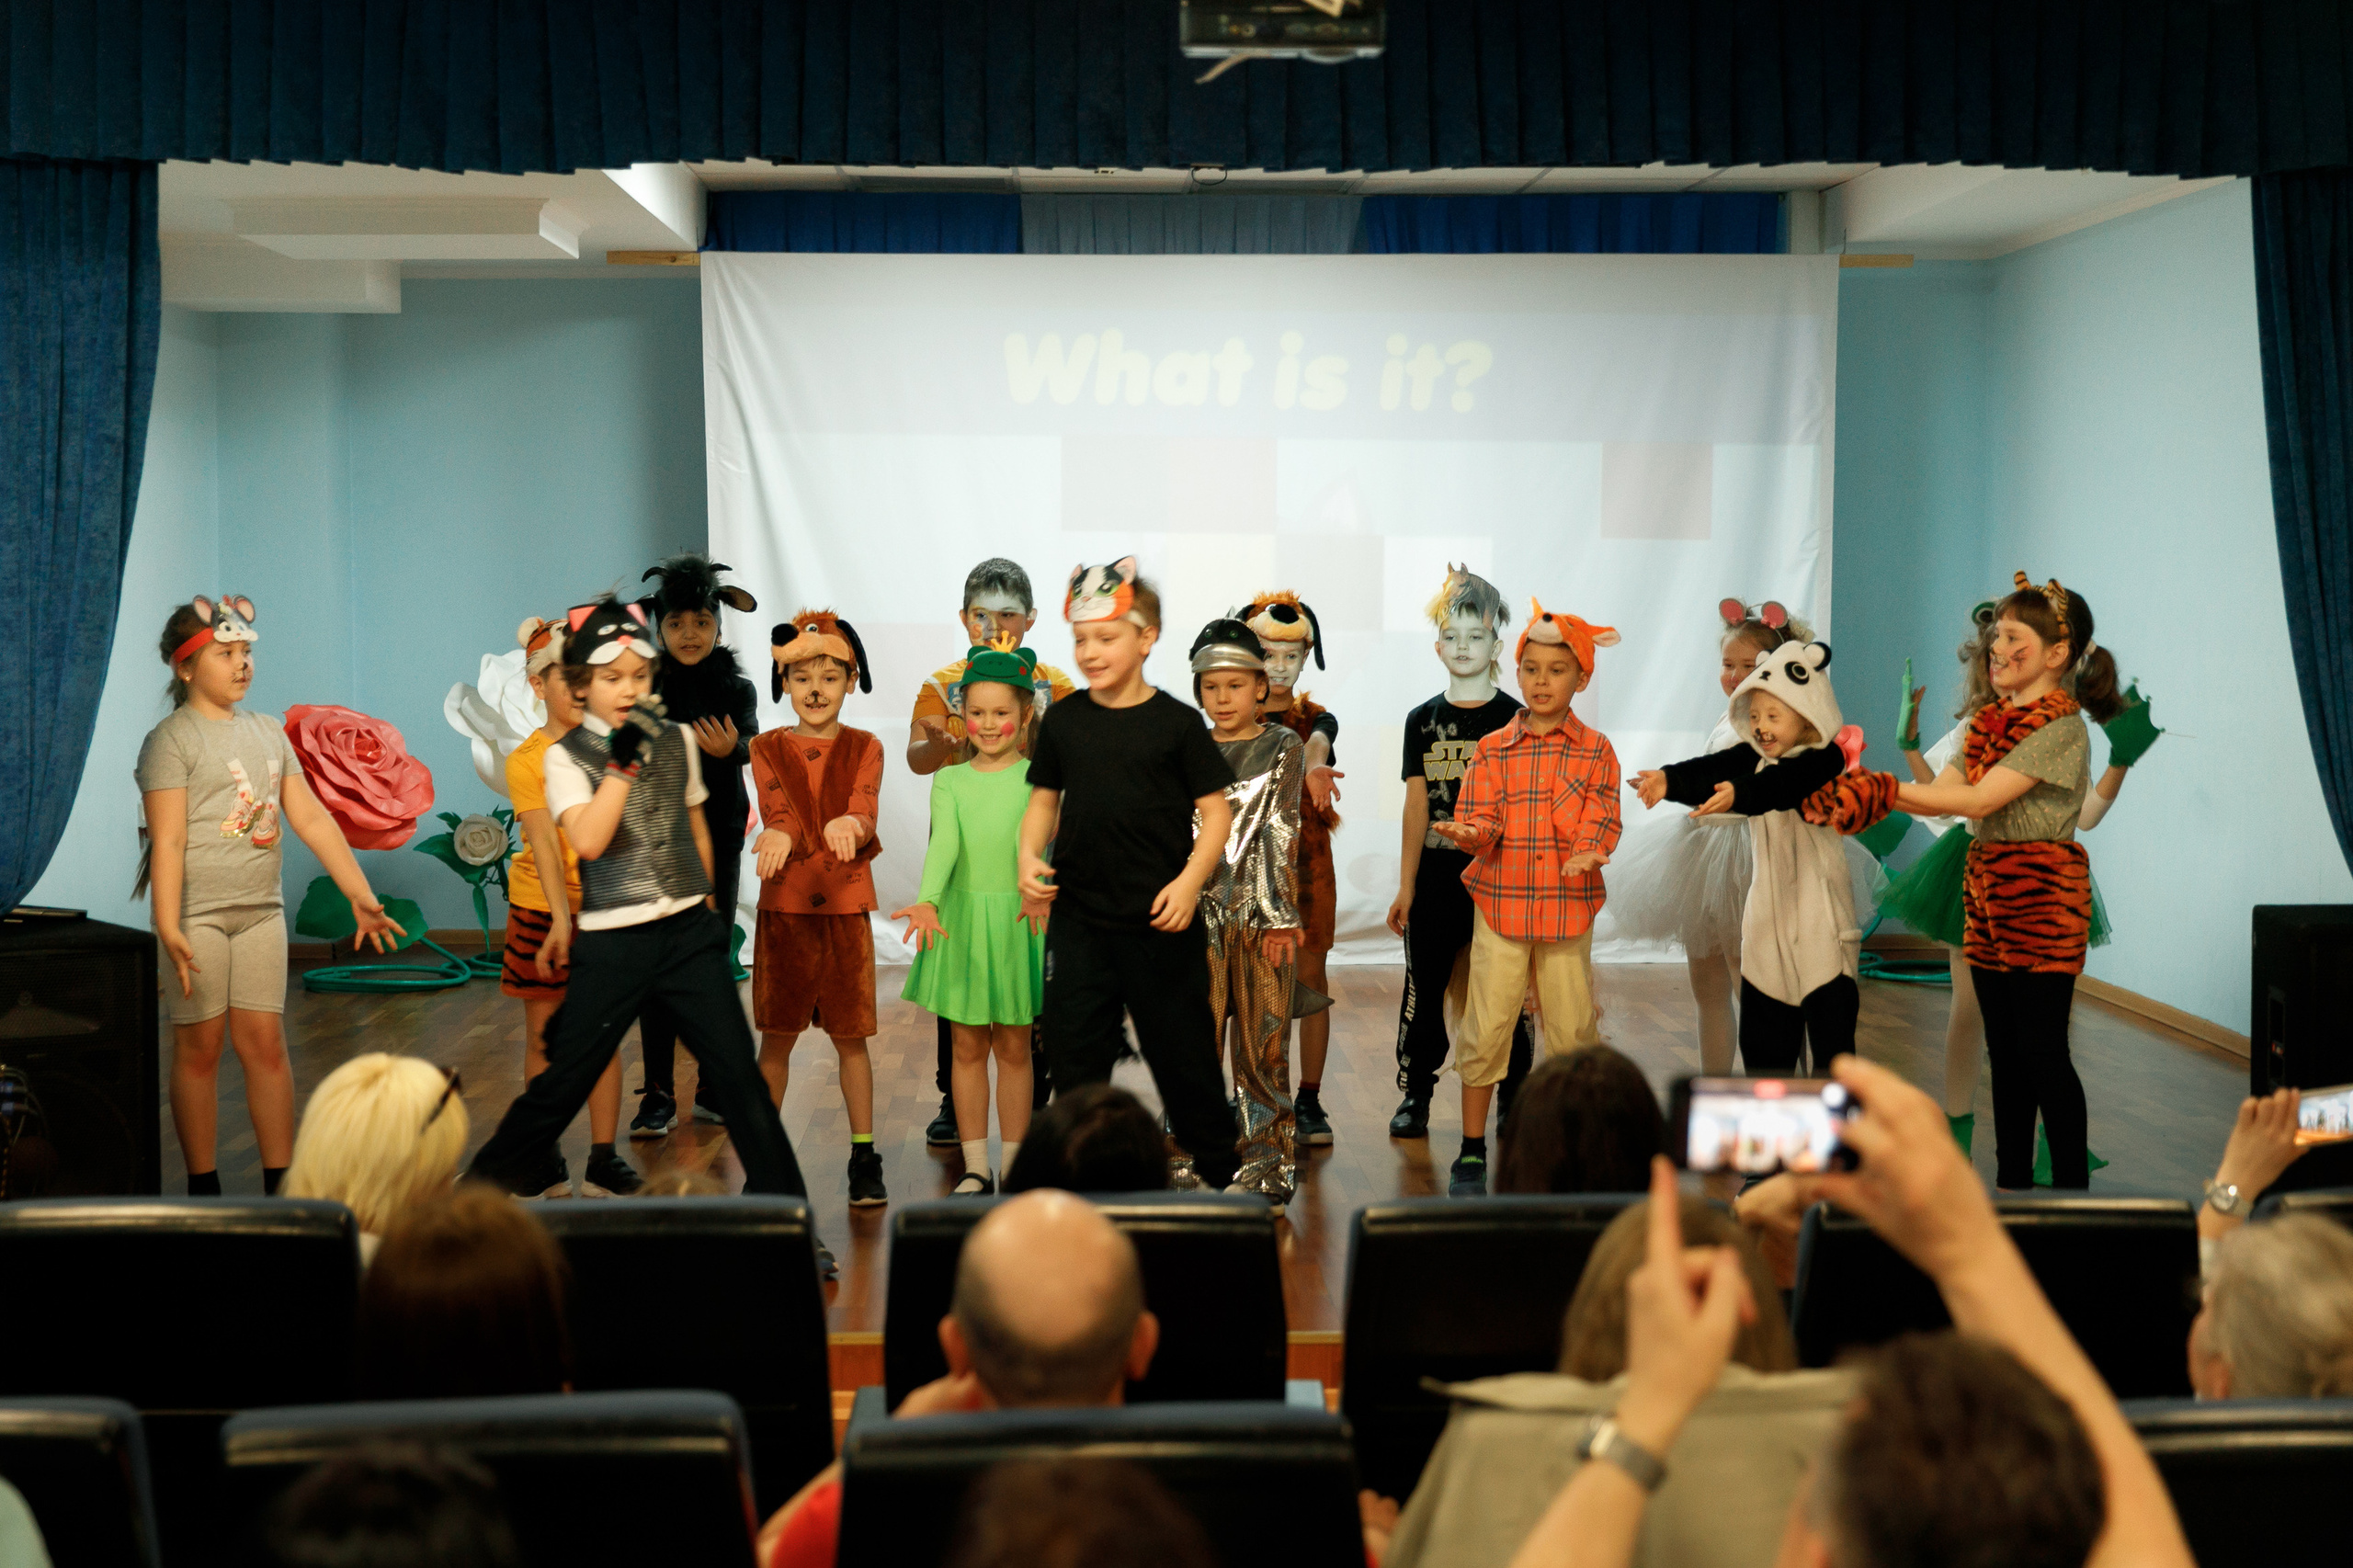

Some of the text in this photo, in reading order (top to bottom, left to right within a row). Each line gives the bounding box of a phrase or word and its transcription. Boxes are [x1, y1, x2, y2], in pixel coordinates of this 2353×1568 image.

[1004, 327, 1493, 413] What is it?
[1423, 741, 1478, 761] STA
[1423, 760, 1470, 781] WA
